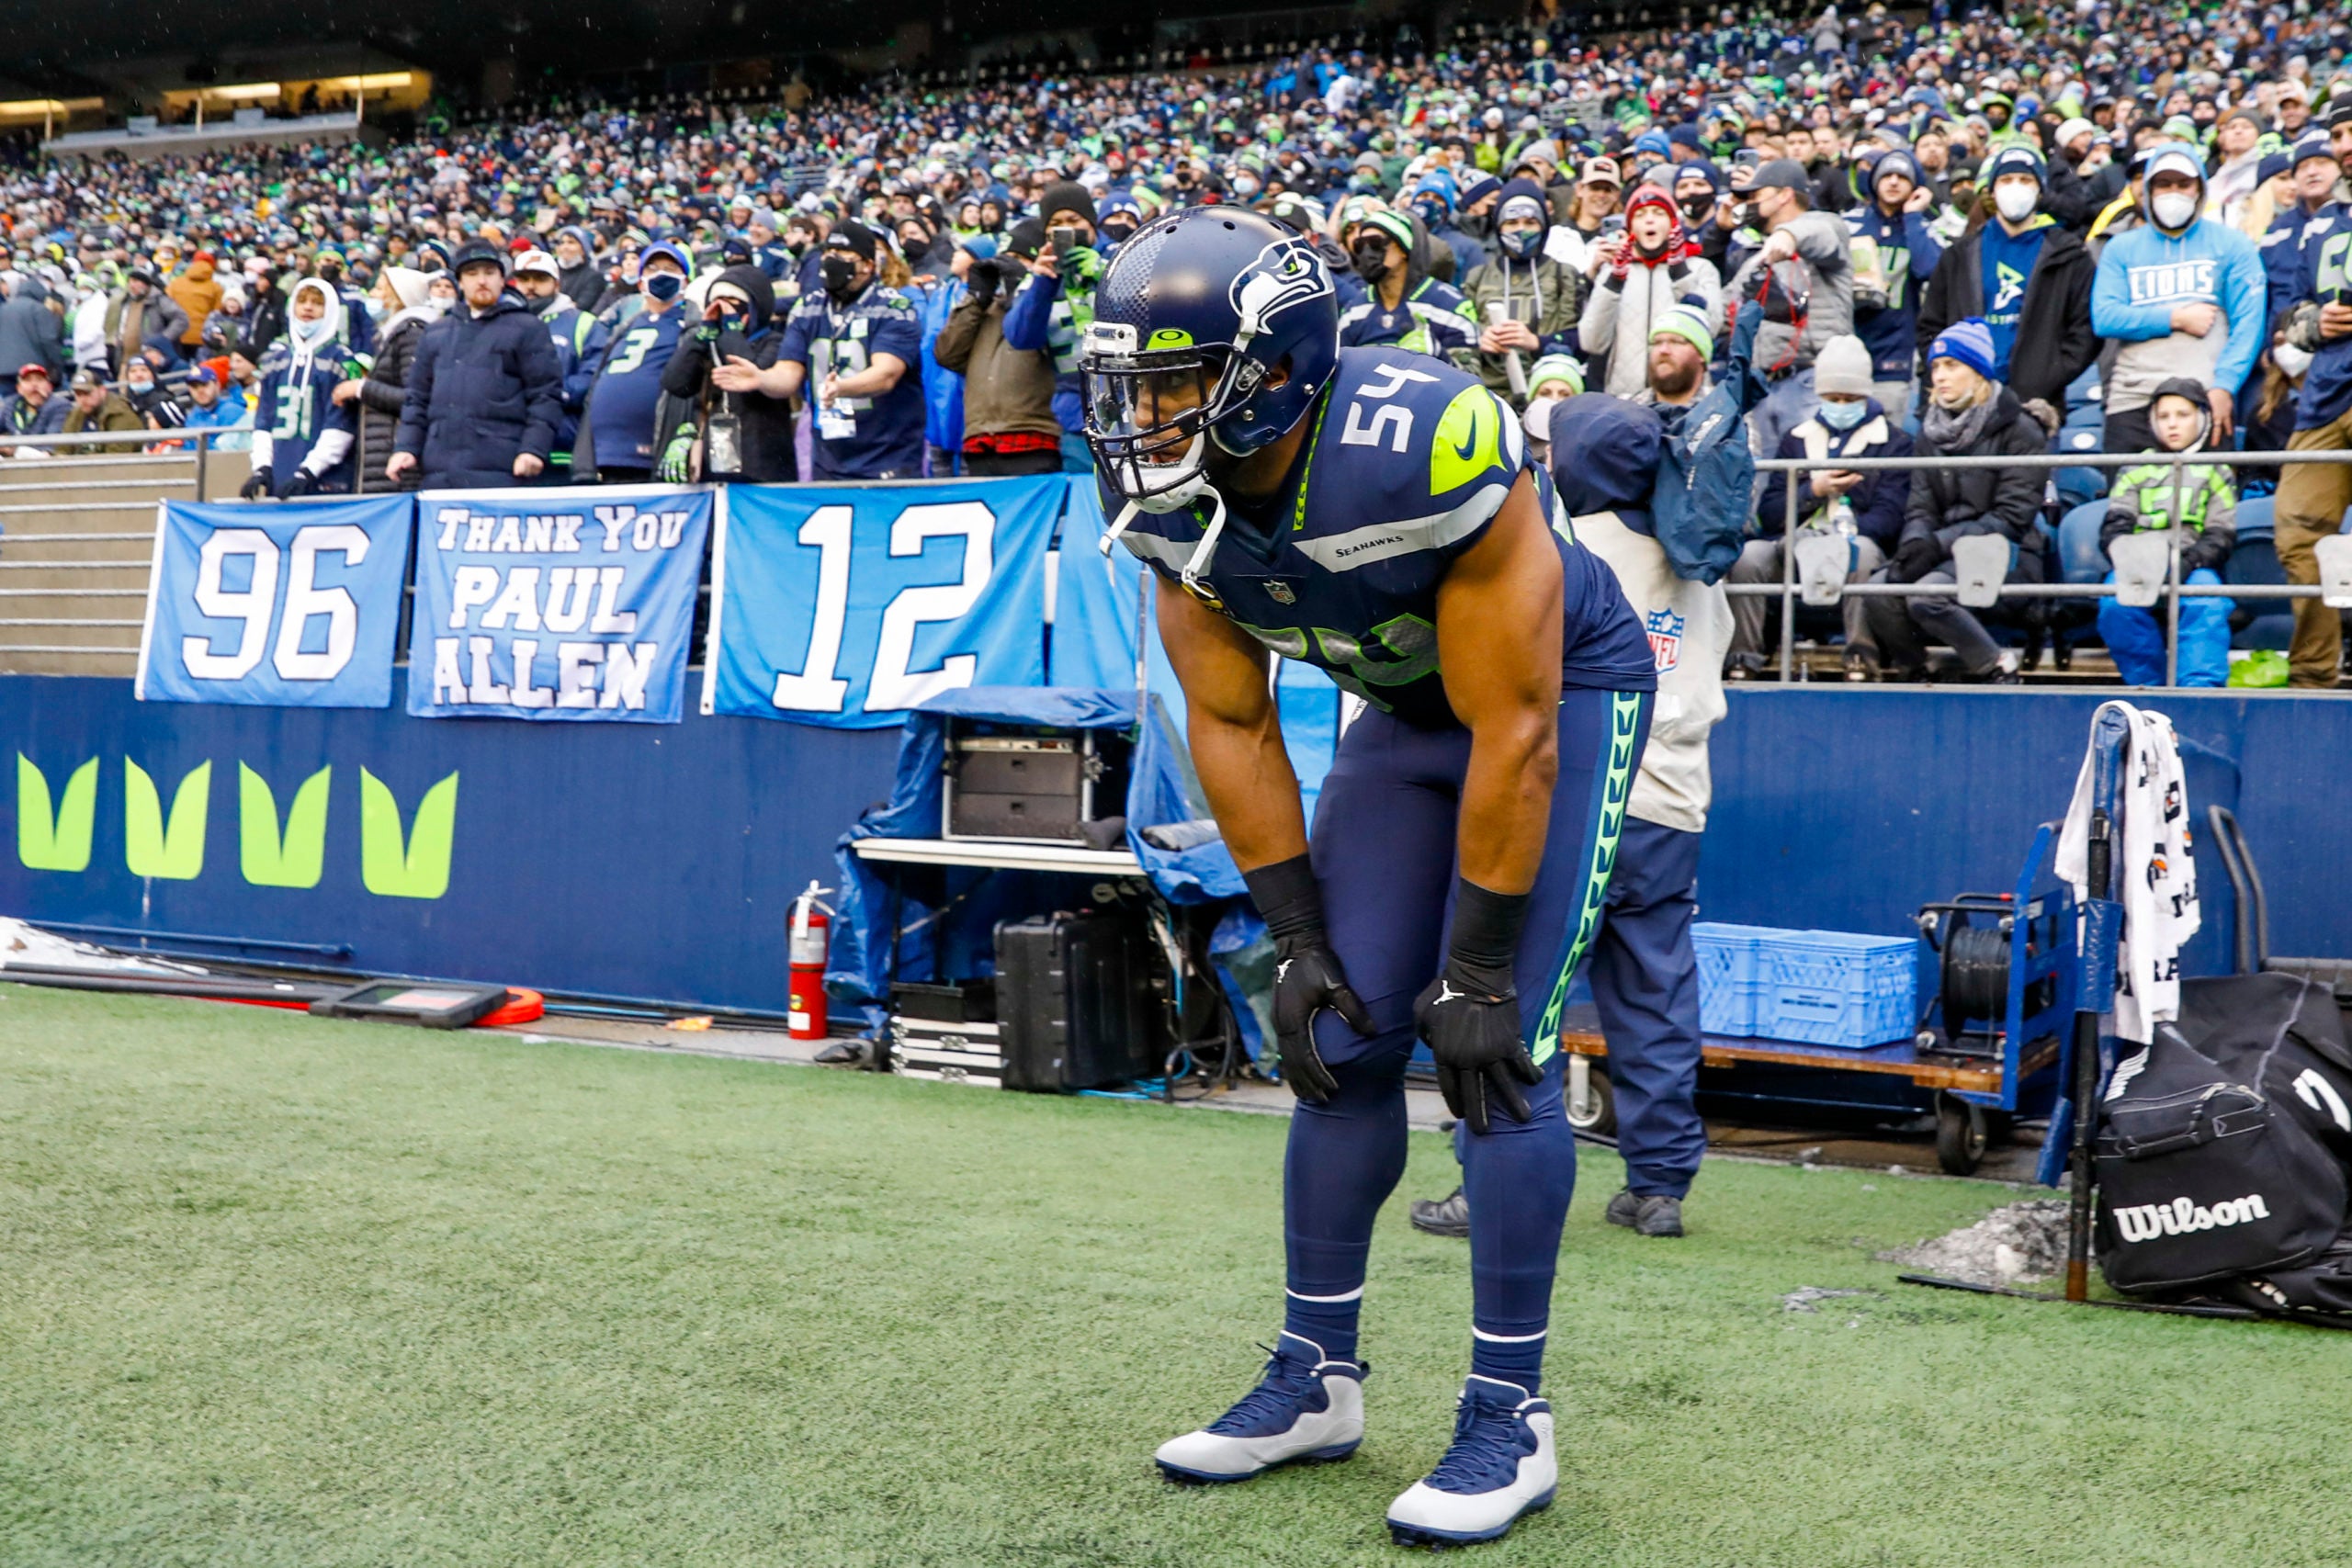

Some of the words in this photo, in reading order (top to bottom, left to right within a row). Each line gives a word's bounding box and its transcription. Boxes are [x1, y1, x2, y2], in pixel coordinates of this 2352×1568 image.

[2130, 265, 2214, 300] LIONS
[607, 328, 659, 374] 3
[808, 337, 873, 410] 12
[271, 385, 314, 441] 31
[1340, 363, 1441, 453] 54
[435, 507, 583, 553] THANK
[594, 504, 689, 551] YOU
[1336, 535, 1404, 558] SEAHAWKS
[181, 523, 371, 682] 96
[448, 564, 639, 634] PAUL
[772, 499, 997, 712] 12
[433, 635, 658, 710] ALLEN
[2113, 1194, 2270, 1243] Wilson
